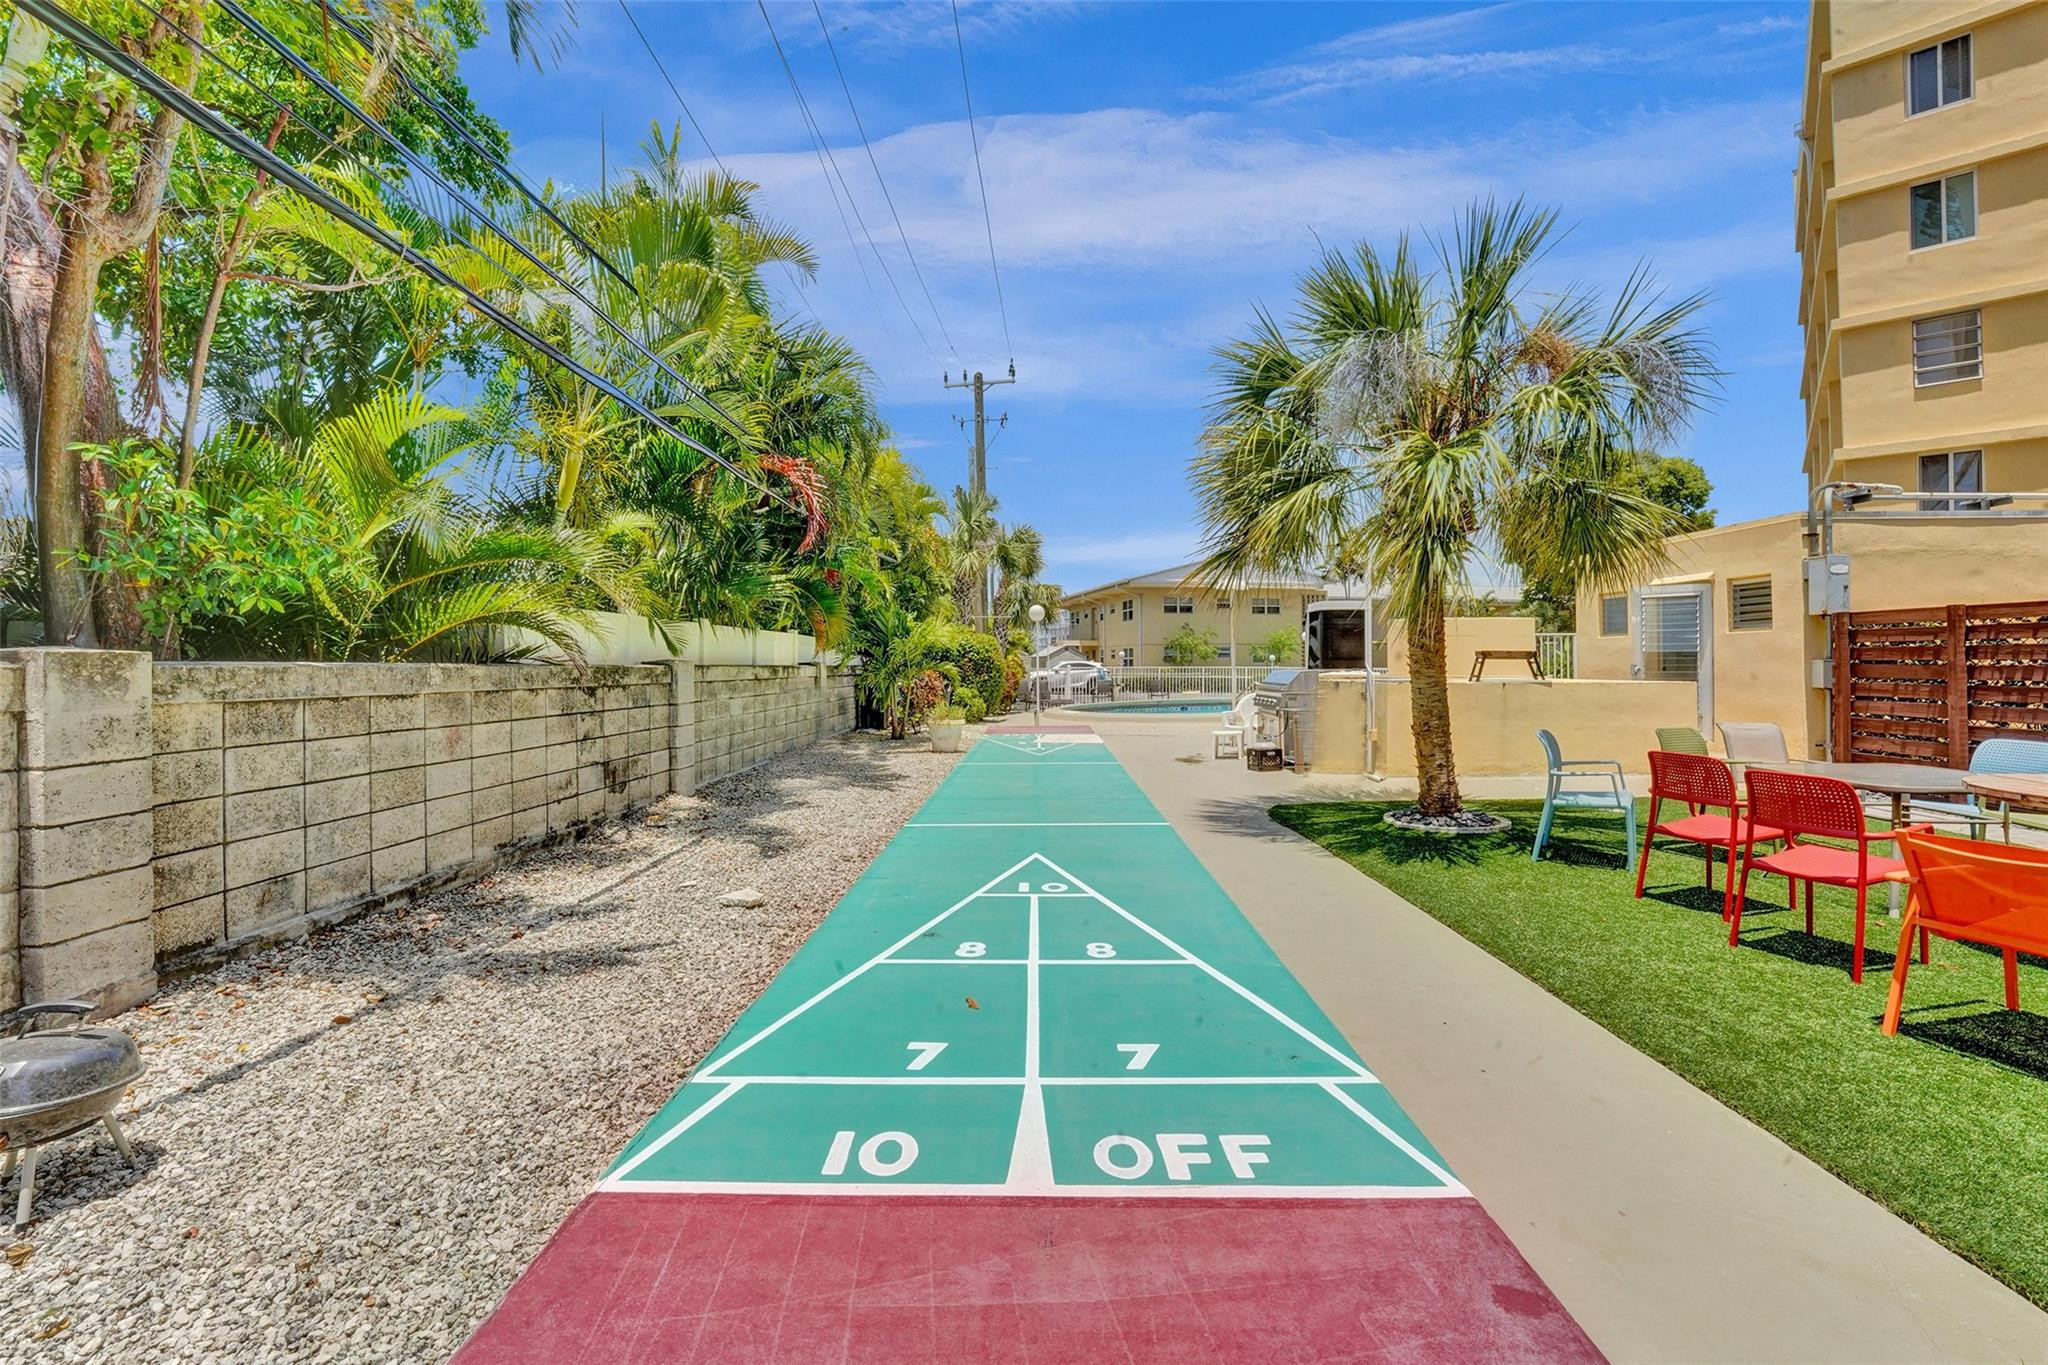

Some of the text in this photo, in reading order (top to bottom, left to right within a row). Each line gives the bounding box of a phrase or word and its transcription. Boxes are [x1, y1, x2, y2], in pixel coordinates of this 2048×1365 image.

[1018, 882, 1069, 893] 10
[954, 941, 987, 958] 8
[1086, 942, 1117, 959] 8
[906, 1041, 949, 1071] 7
[1116, 1043, 1161, 1070] 7
[820, 1130, 1272, 1181] 10 OFF
